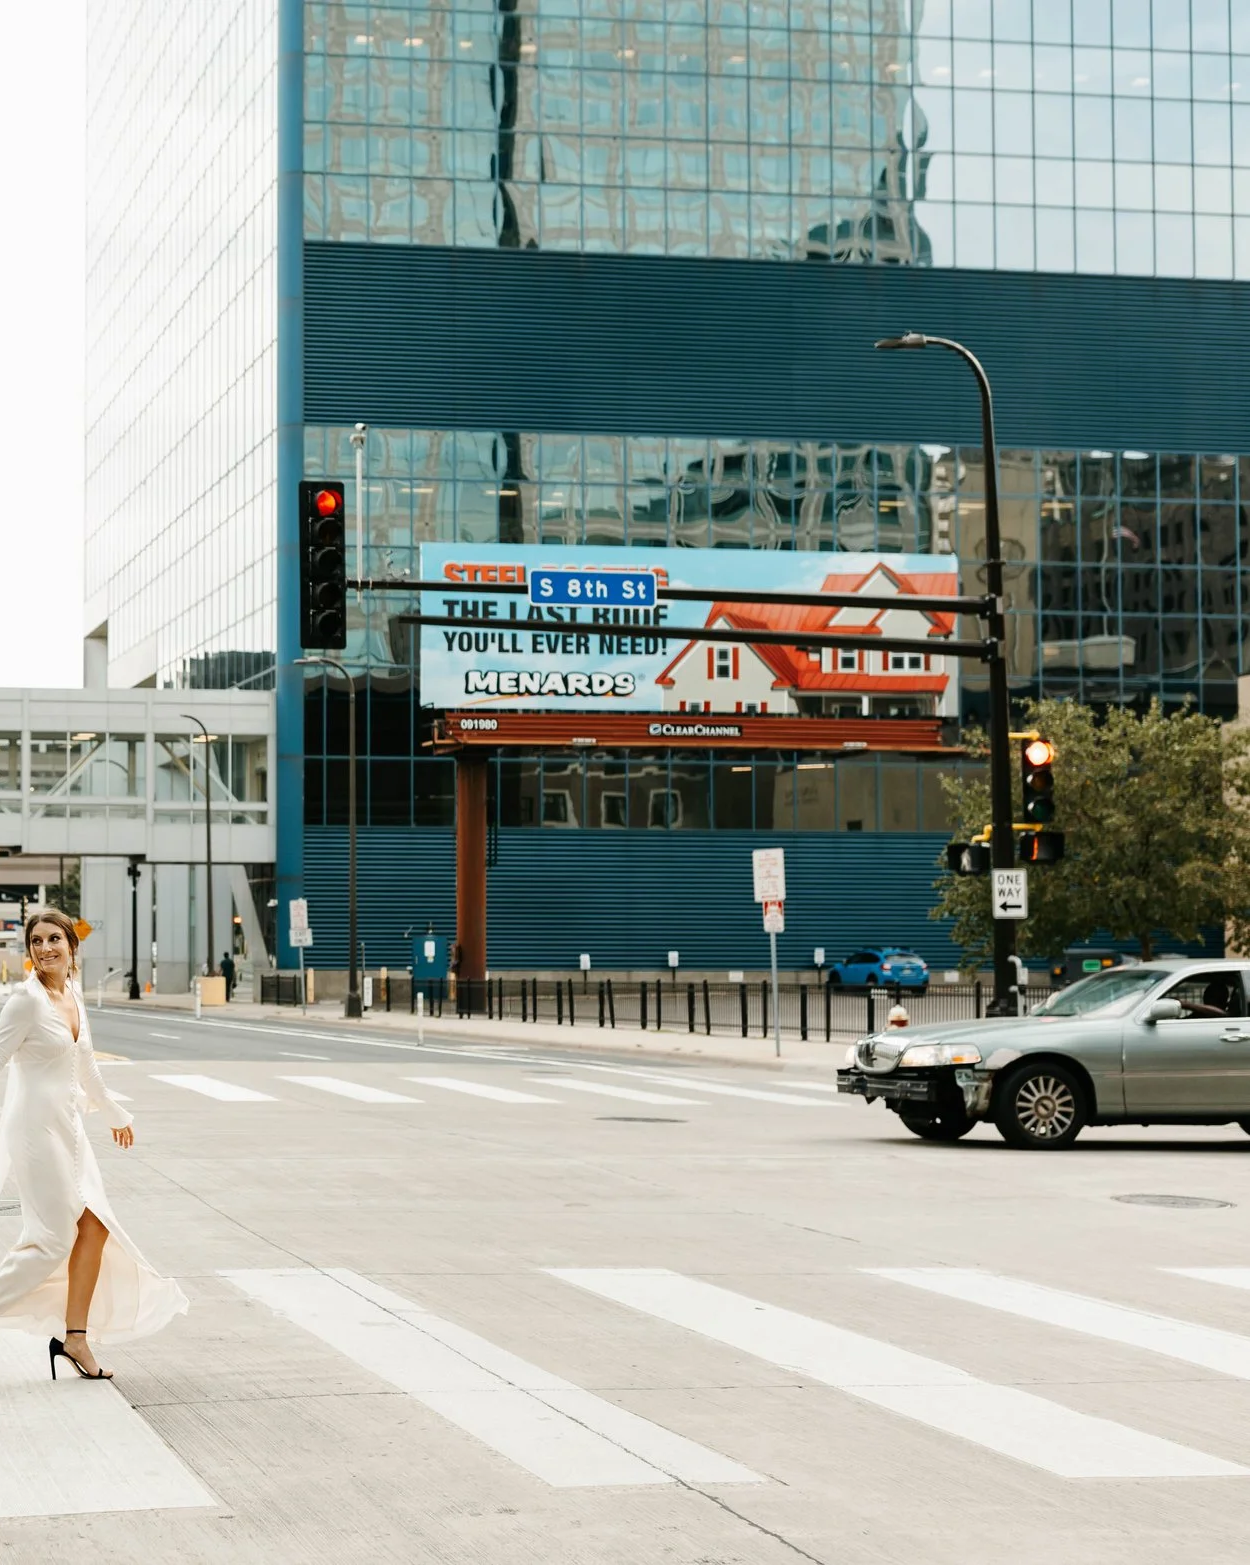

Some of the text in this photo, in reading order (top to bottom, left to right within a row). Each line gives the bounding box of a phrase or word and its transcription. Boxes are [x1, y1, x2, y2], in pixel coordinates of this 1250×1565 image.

[443, 562, 527, 584] STEEL
[539, 577, 647, 600] S 8th St
[442, 599, 498, 620] THE
[442, 630, 668, 656] YOU'LL EVER NEED!
[464, 669, 637, 697] MENARDS
[998, 874, 1022, 885] ONE
[998, 888, 1022, 898] WAY
